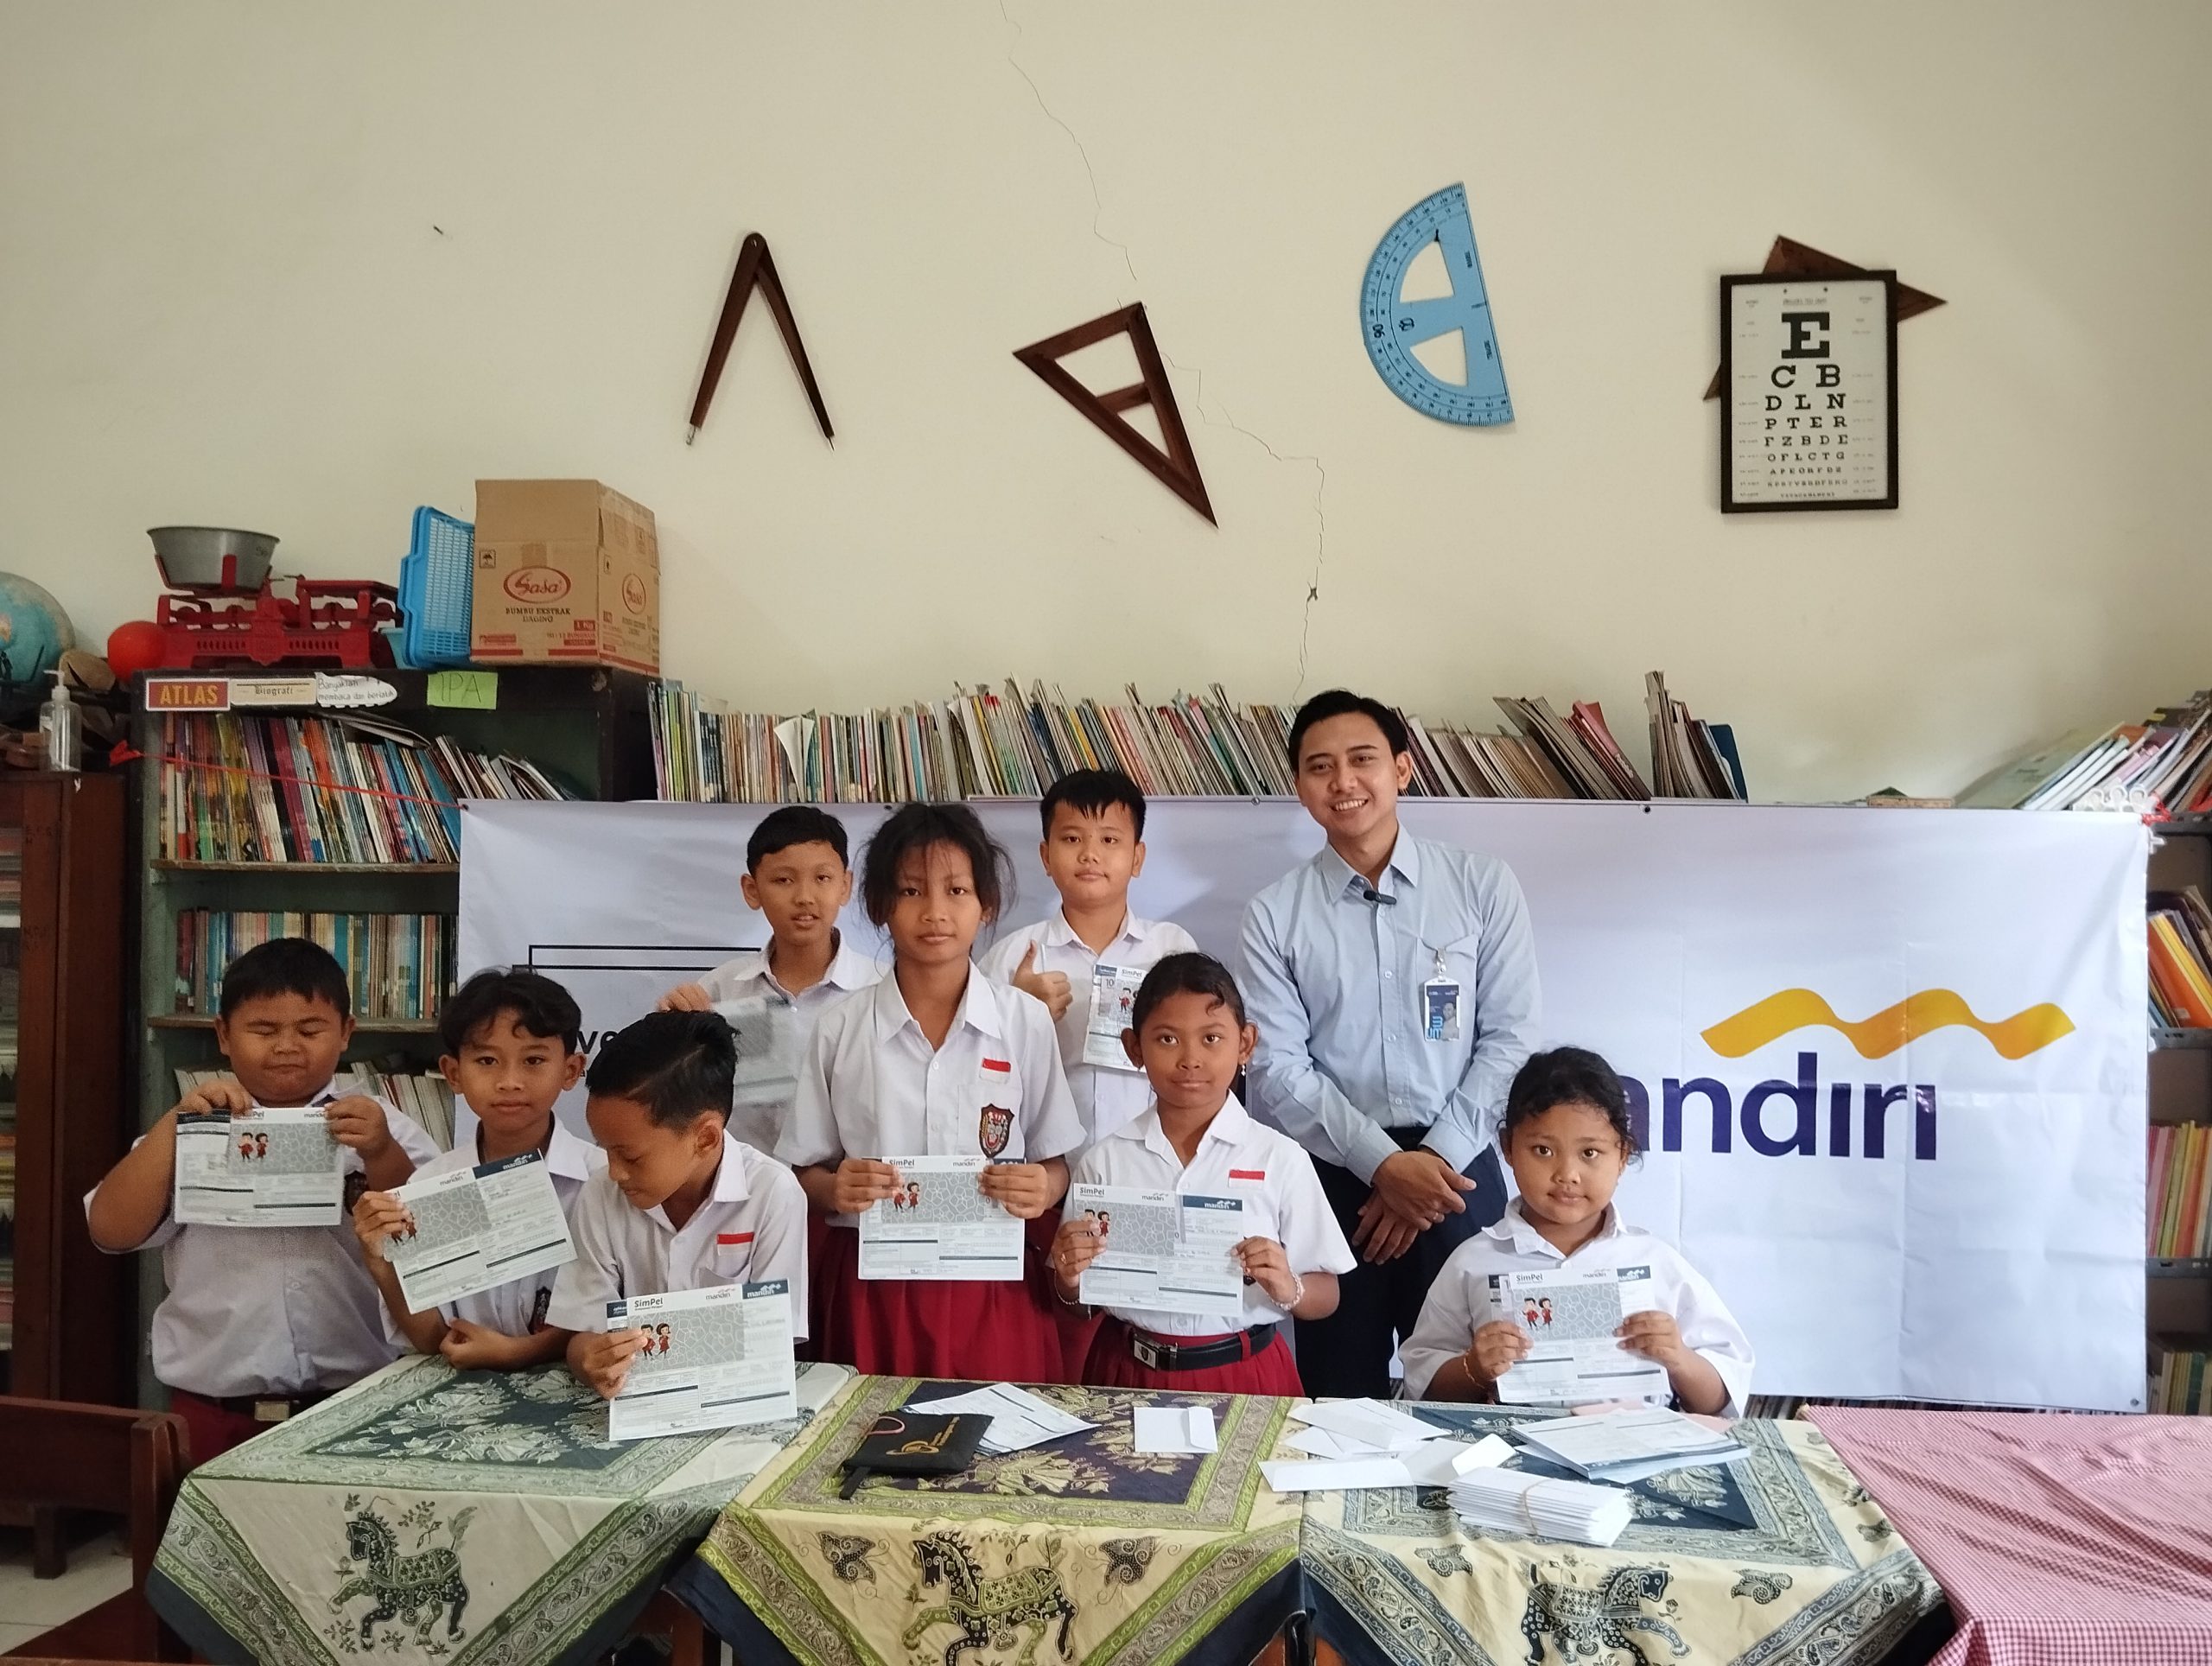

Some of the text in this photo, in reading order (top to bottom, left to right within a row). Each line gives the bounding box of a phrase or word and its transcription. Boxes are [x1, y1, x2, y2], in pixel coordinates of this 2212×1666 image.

[1782, 312, 1830, 359] E
[1771, 364, 1840, 388] C B
[515, 571, 559, 595] Sasa
[160, 685, 218, 705] ATLAS
[255, 684, 294, 696] Biografi
[441, 672, 482, 703] IPA
[1618, 1052, 1937, 1160] ndiri
[634, 1297, 663, 1307] SimPel
